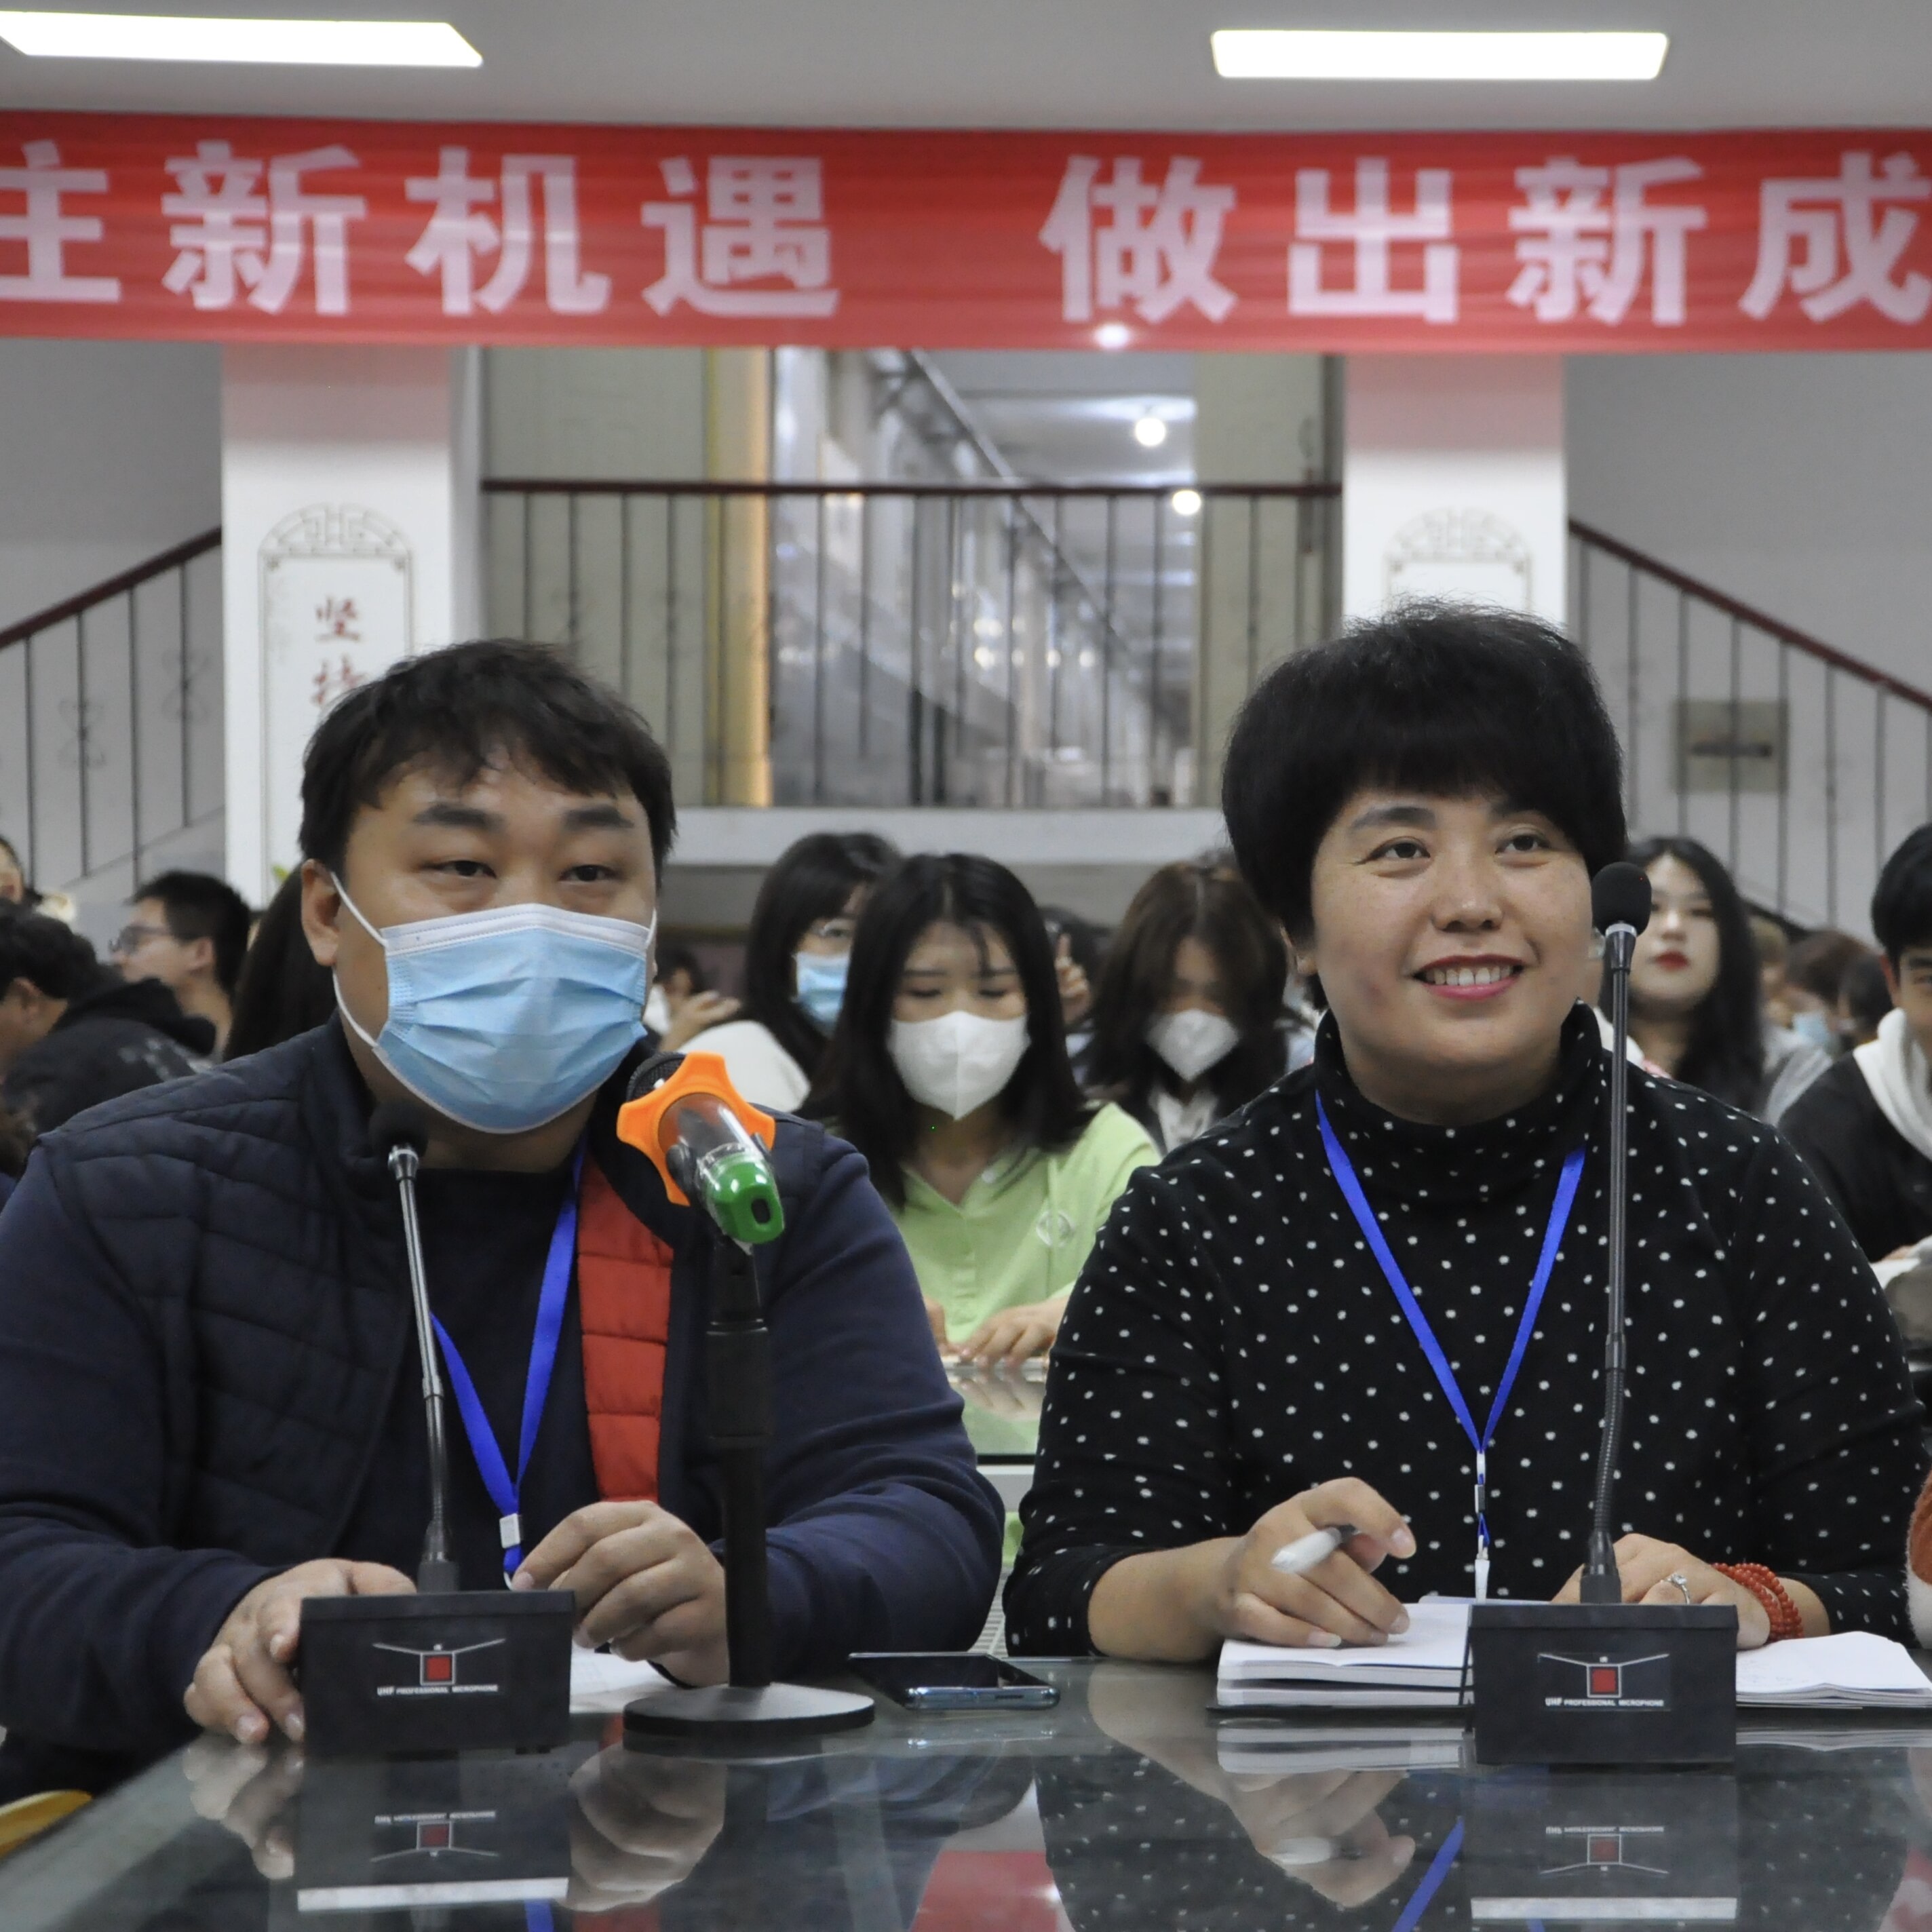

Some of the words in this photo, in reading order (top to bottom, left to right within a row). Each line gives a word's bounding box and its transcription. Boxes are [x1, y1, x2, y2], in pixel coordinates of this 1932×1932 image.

[1039, 151, 1932, 324] 做出新成
[1545, 1697, 1563, 1707] UHF
[1564, 1699, 1616, 1707] PROFESSIONAL
[1619, 1699, 1665, 1707] MICROPHONE
